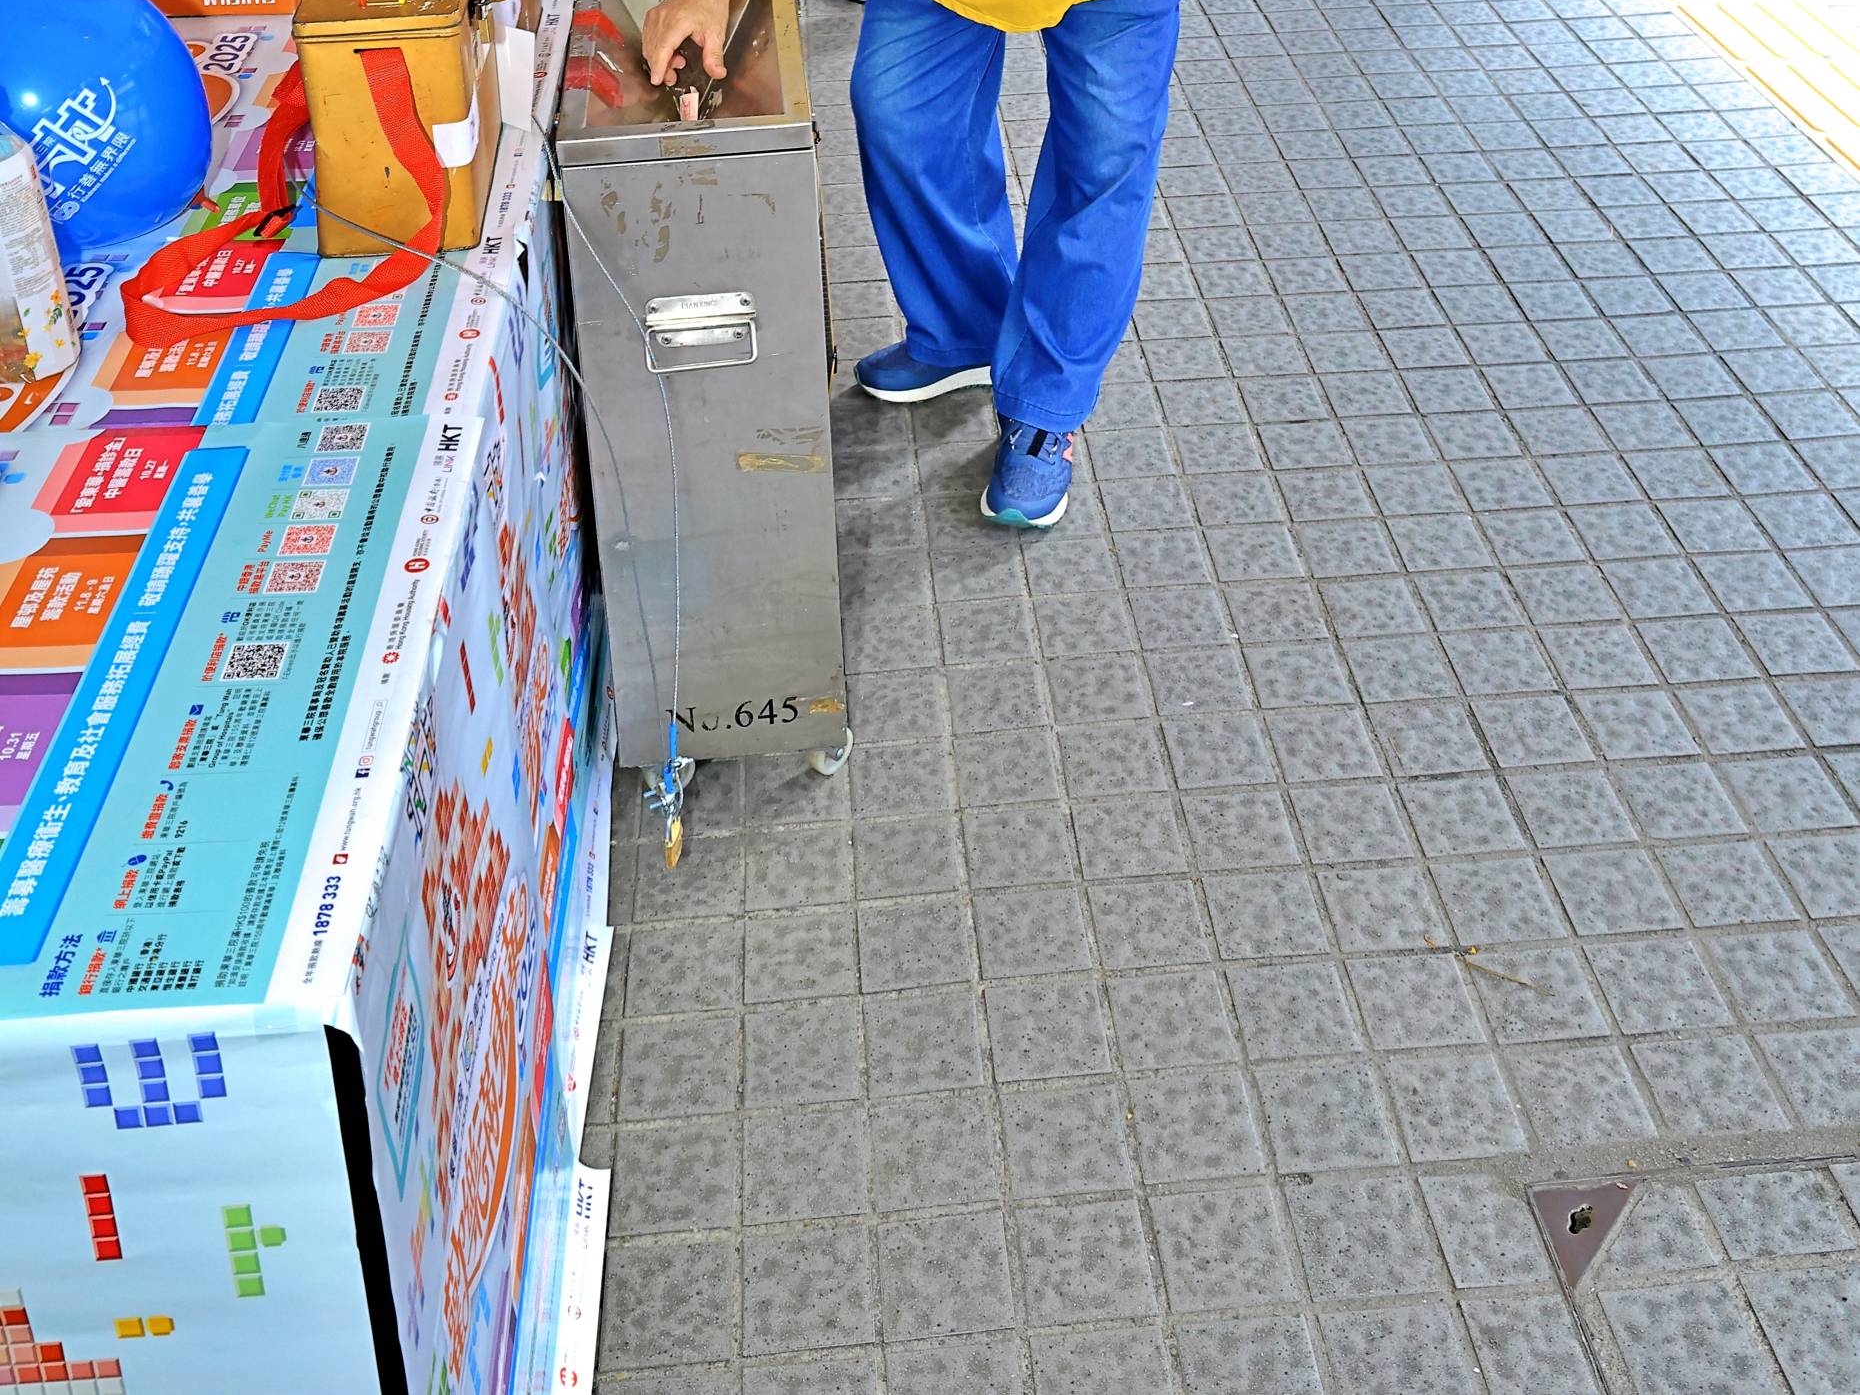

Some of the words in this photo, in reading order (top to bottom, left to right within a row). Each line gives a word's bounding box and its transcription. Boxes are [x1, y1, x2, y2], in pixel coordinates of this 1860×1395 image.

[203, 35, 251, 73] 2025
[67, 131, 131, 200] 行善無界限
[479, 236, 505, 254] HKT
[66, 266, 104, 318] 025
[295, 431, 311, 448] 八達通
[437, 423, 464, 451] HKT
[103, 448, 142, 499] 中醫籌款日
[137, 459, 158, 479] 10.27
[440, 455, 455, 472] LINK
[263, 494, 281, 518] WeChat
[276, 504, 290, 516] Pay
[257, 529, 275, 552] PayMe
[234, 564, 254, 591] 中銀香港
[406, 578, 420, 599] Authority
[39, 571, 83, 622] 籌款活動
[87, 575, 116, 615] 星期六及日
[401, 600, 414, 620] Housing
[397, 621, 409, 634] Kong
[393, 635, 405, 649] Hong
[15, 731, 41, 761] 星期五
[174, 819, 188, 839] 9216
[338, 786, 363, 851] www.tungwah.org.hk
[112, 866, 140, 910] 網上捐款
[321, 873, 341, 900] 333
[311, 901, 335, 937] 1878
[581, 929, 598, 964] HKT
[37, 933, 83, 996] 捐款方法
[482, 947, 497, 998] Charity
[517, 908, 537, 1045] 2025
